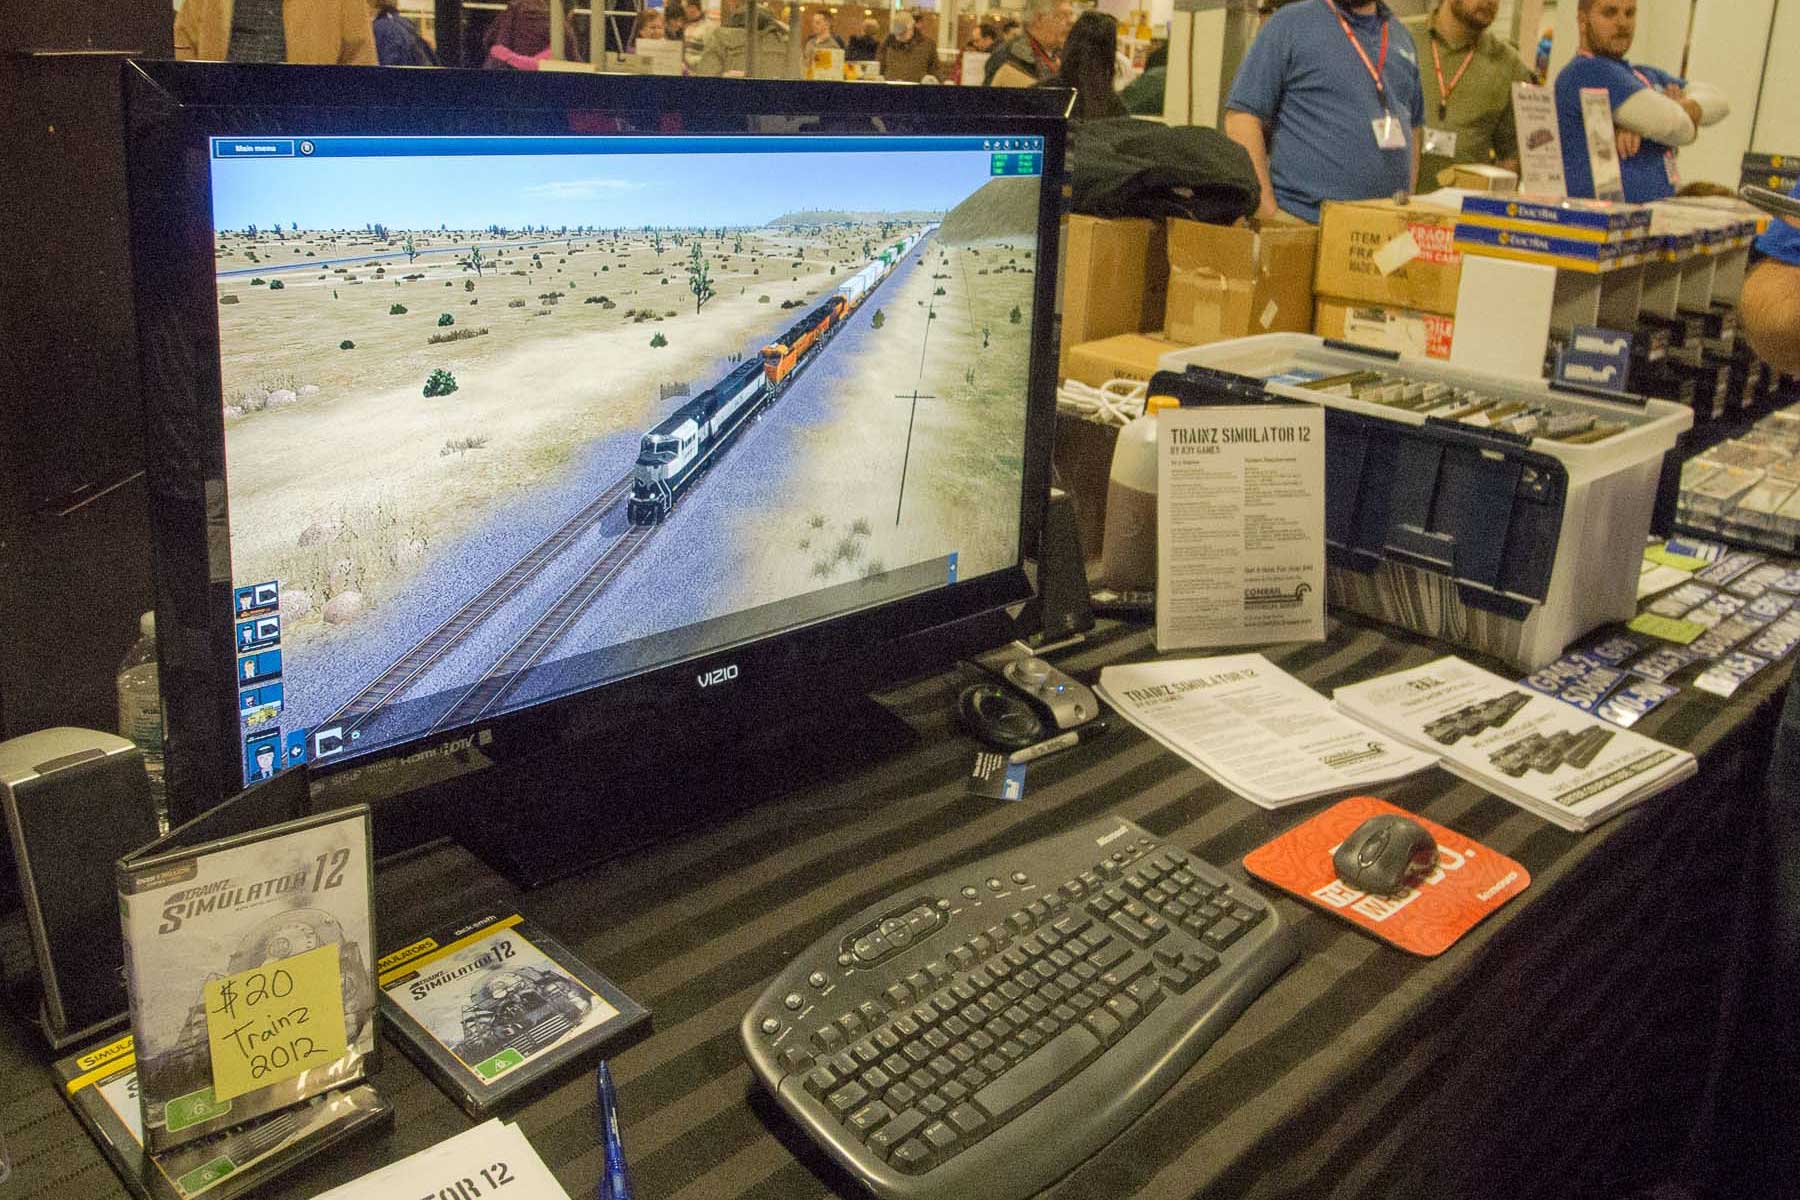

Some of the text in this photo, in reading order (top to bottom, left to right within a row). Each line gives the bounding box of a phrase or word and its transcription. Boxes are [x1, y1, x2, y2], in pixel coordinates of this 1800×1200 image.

[1171, 426, 1311, 444] TRAINZ SIMULATOR 12
[697, 664, 739, 688] VIZIO
[1122, 684, 1174, 701] TRAINZ
[1172, 671, 1241, 692] SIMULATOR
[158, 870, 306, 934] SIMULATOR
[311, 848, 351, 893] 12
[184, 879, 231, 901] TRAINZ
[1476, 871, 1518, 901] lenovo
[410, 954, 493, 1001] SIMULATOR
[490, 940, 516, 962] 12
[212, 969, 293, 1019] $20
[222, 1007, 310, 1058] Trainz
[251, 1037, 329, 1079] 2012
[480, 1162, 515, 1190] 12
